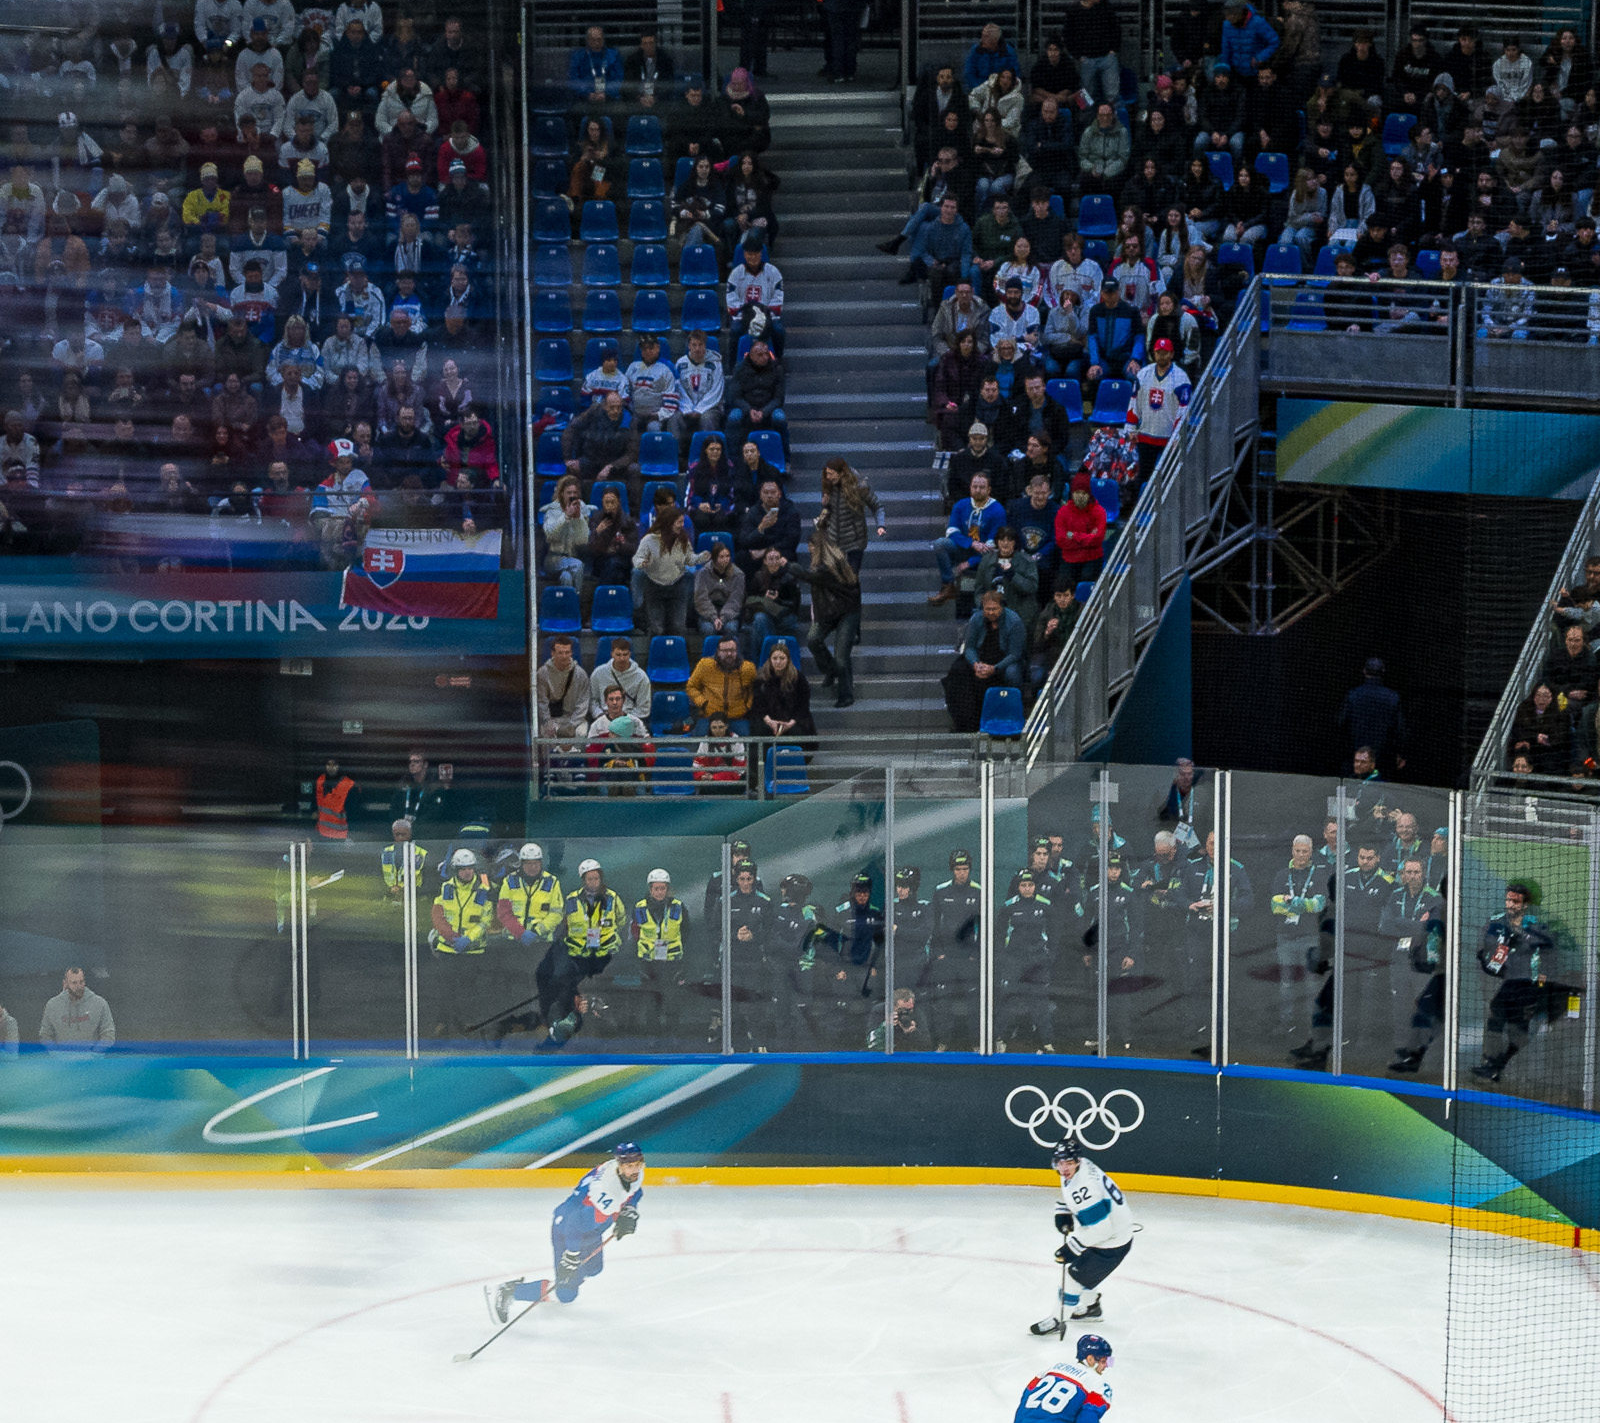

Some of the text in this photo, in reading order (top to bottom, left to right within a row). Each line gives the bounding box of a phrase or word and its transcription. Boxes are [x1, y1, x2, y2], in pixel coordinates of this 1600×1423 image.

[128, 599, 327, 634] CORTINA
[597, 1191, 613, 1210] 14
[1071, 1186, 1092, 1205] 62
[1025, 1374, 1078, 1414] 28
